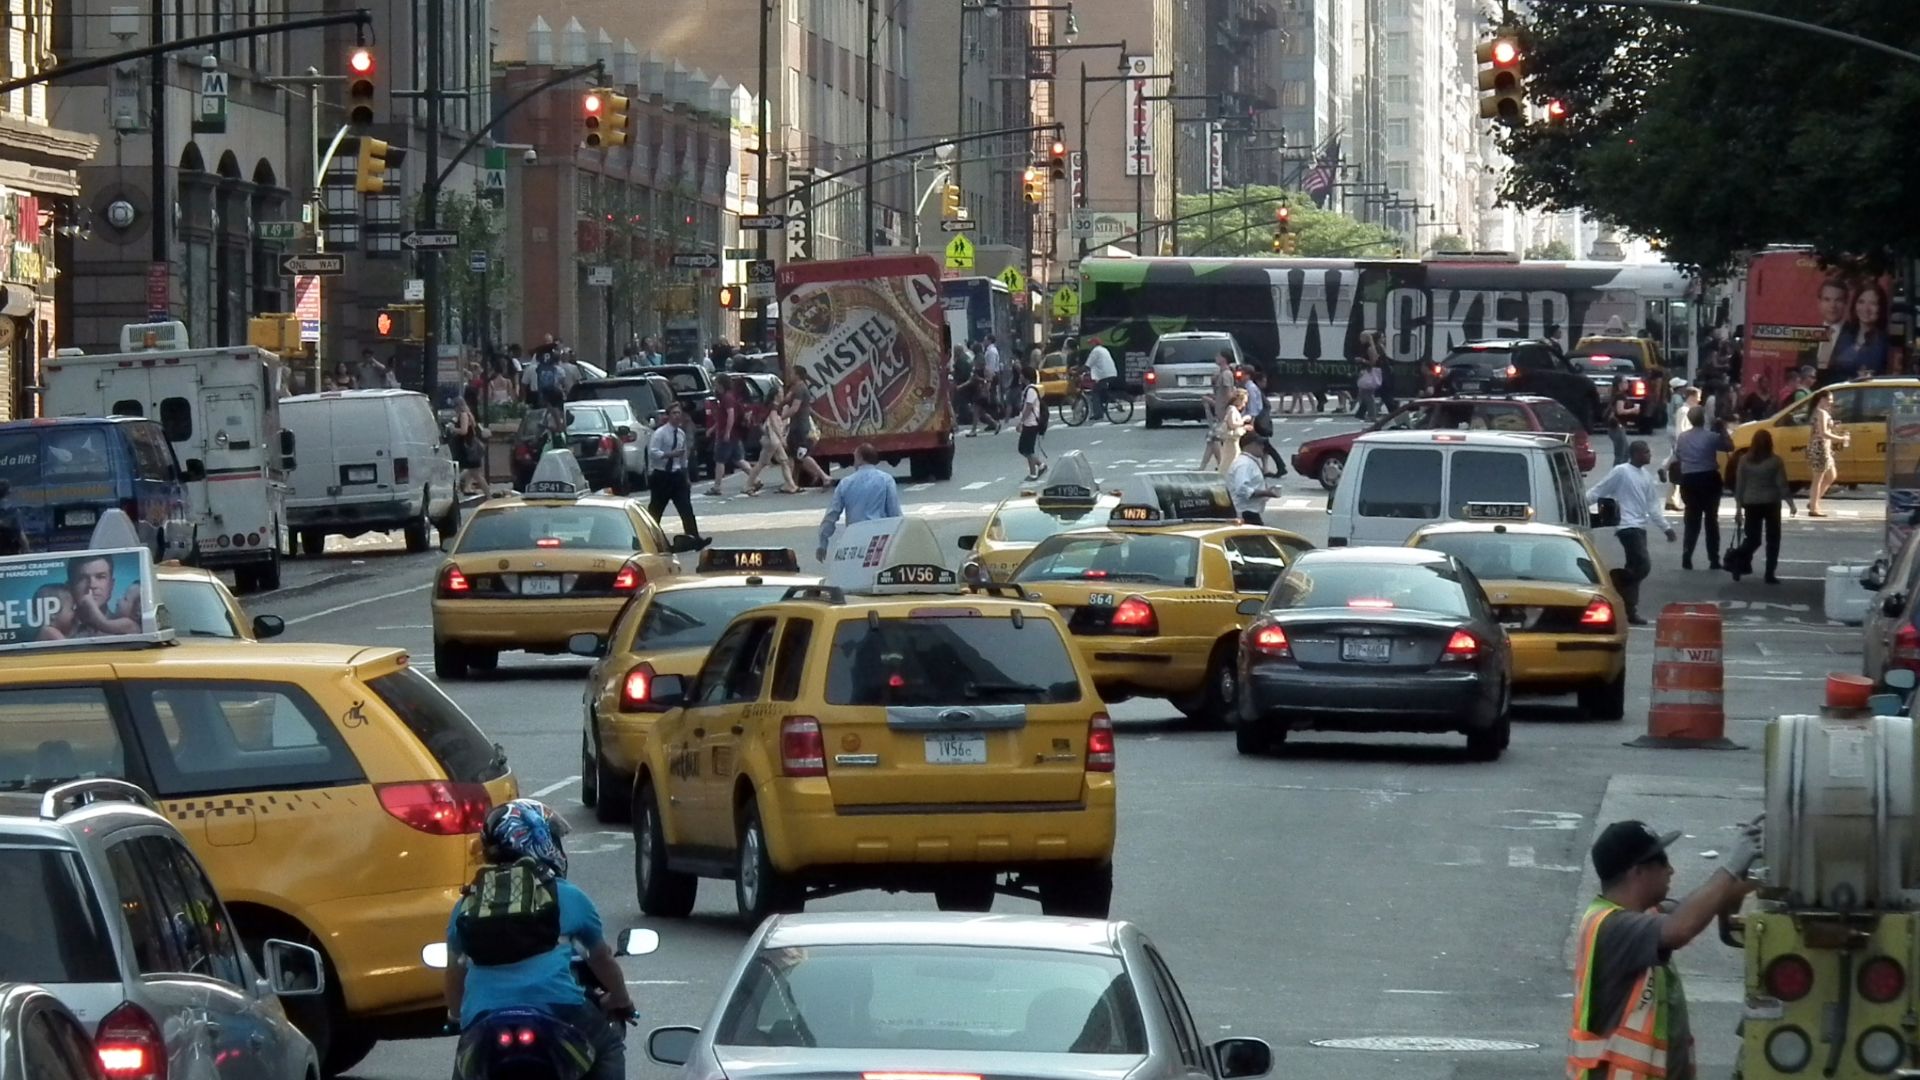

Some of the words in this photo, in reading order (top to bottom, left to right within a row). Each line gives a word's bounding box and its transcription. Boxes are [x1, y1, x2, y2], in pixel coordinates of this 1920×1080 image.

[787, 179, 807, 259] PARK
[260, 223, 268, 237] W
[270, 223, 282, 237] 49
[1075, 220, 1091, 230] 30
[407, 236, 423, 246] ONE
[434, 236, 452, 244] WAY
[289, 260, 307, 270] ONE
[319, 260, 338, 269] WAY
[804, 315, 893, 400] AMSTEL
[734, 552, 762, 567] 1A48
[28, 561, 65, 570] CRASHERS
[6, 569, 48, 578] HANGOVER
[899, 566, 934, 582] 1V56
[1090, 593, 1113, 605] 864
[10, 631, 16, 640] 5
